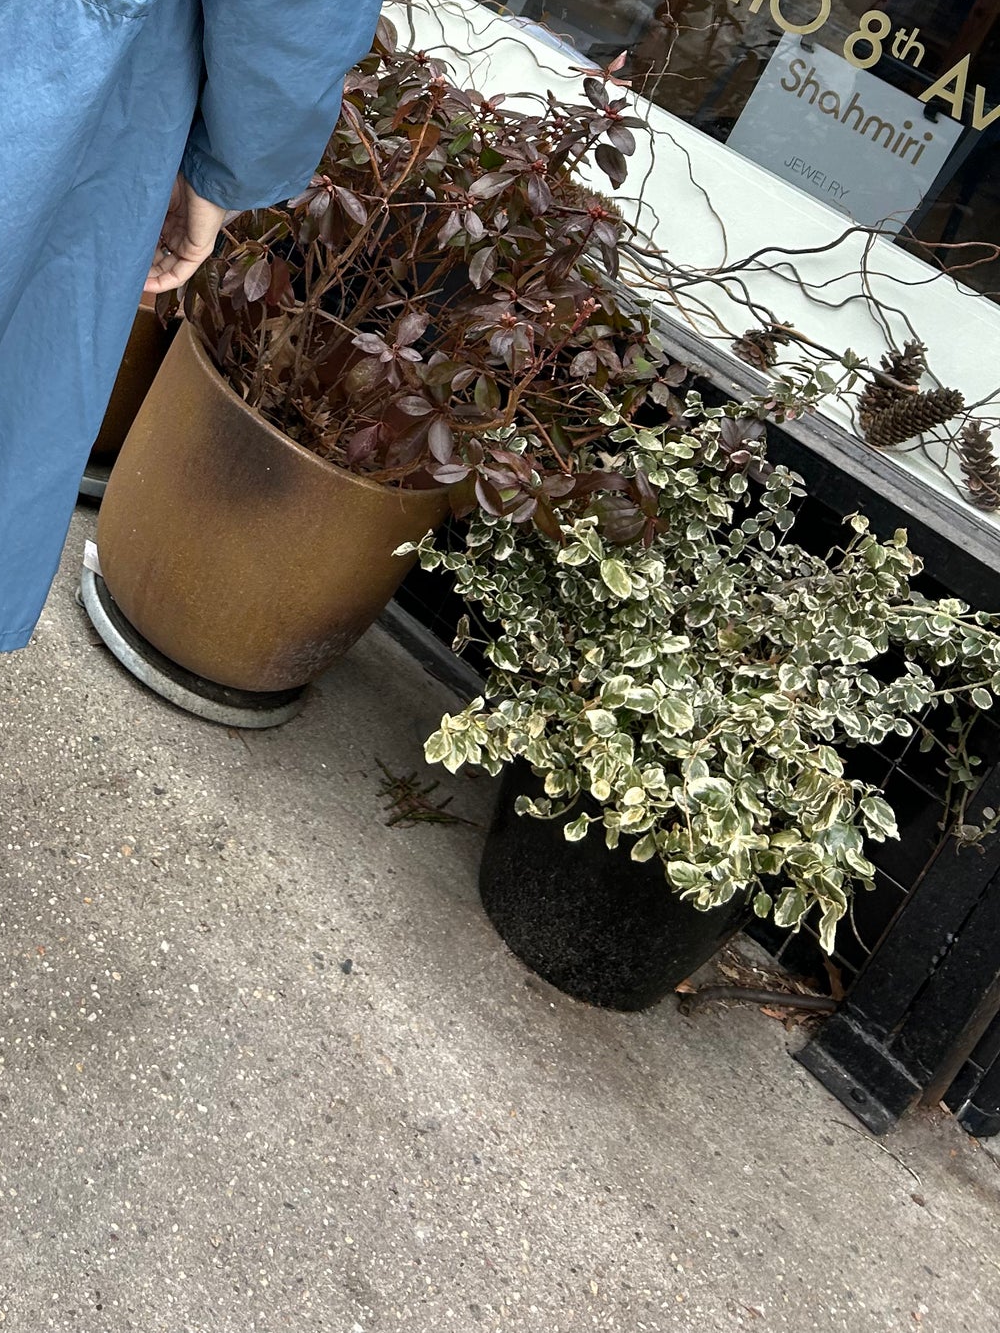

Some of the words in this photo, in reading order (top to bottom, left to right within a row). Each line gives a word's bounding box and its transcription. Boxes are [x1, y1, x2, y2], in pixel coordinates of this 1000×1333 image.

[843, 9, 926, 69] 8th
[780, 58, 934, 166] Shahmiri
[783, 155, 851, 201] JEWELRY
